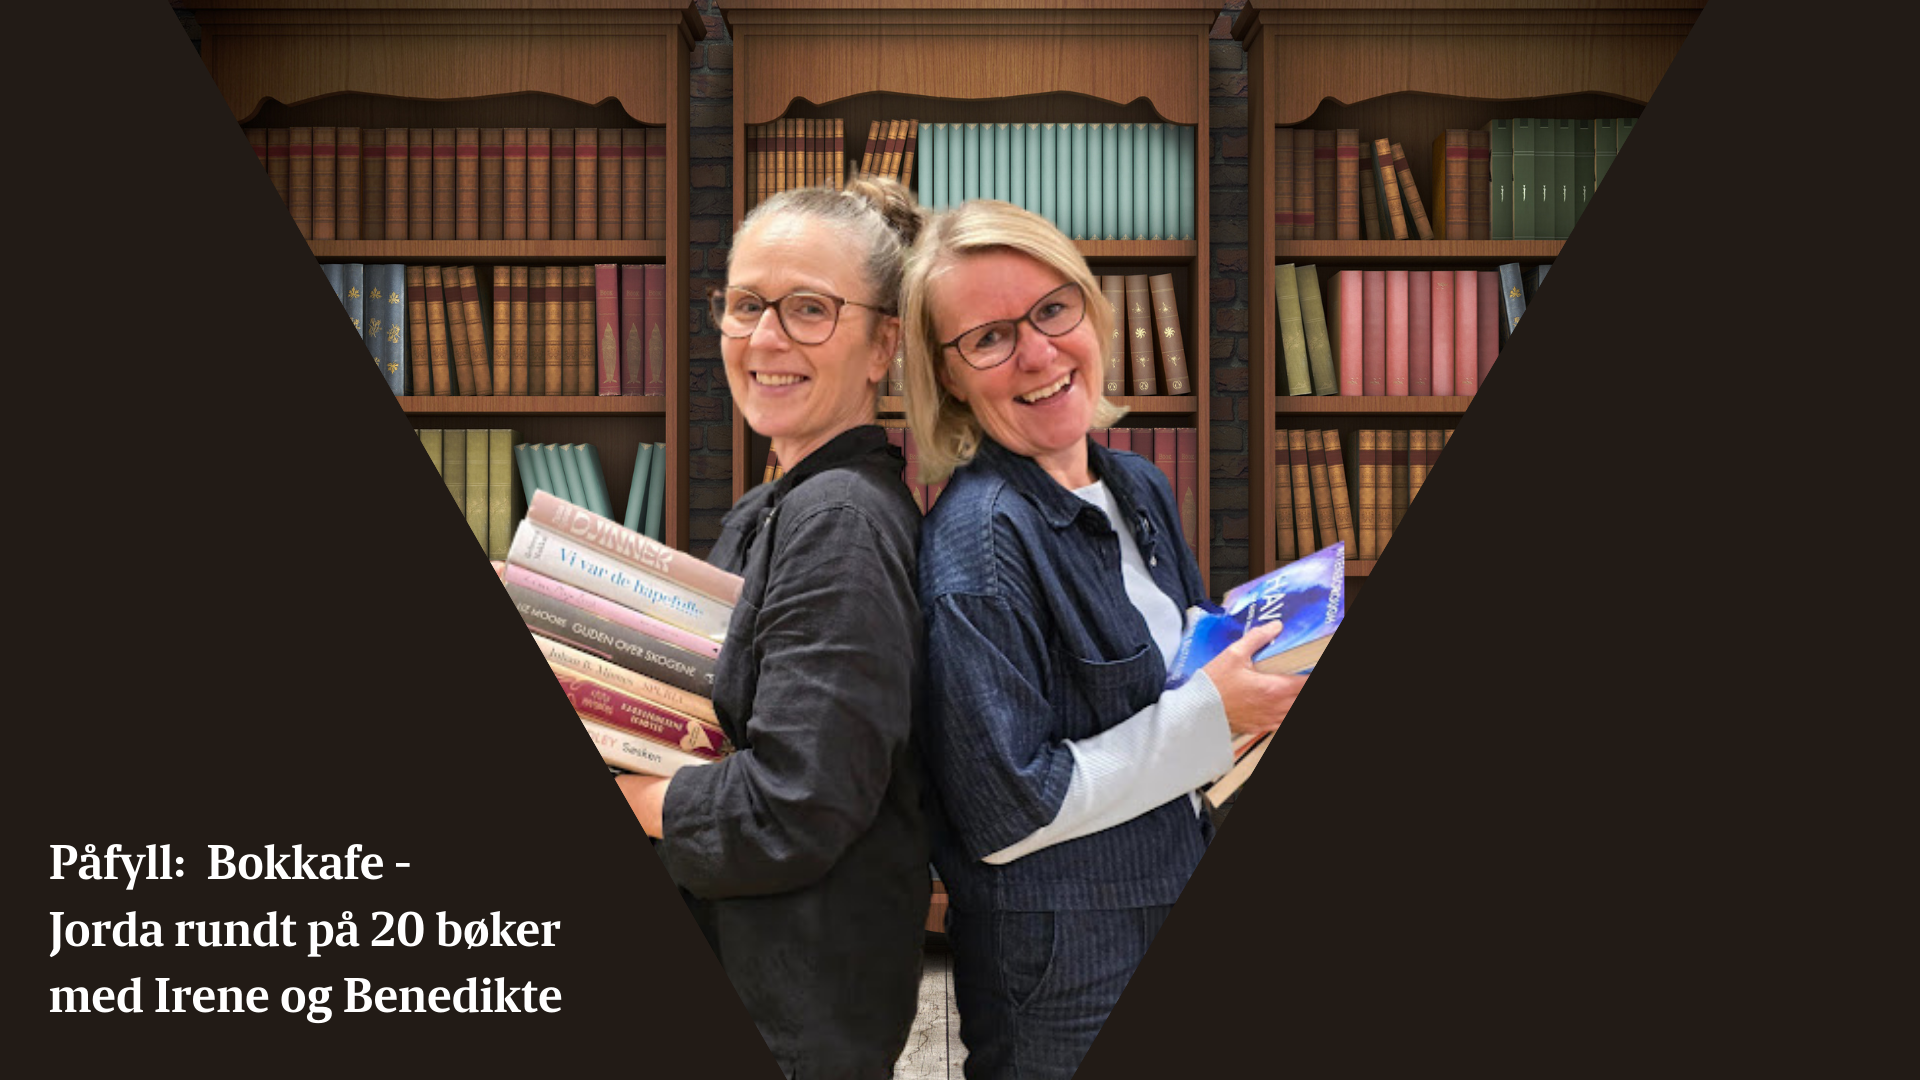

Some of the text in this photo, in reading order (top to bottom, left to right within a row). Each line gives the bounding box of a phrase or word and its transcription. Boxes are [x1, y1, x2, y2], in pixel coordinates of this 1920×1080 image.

[560, 548, 577, 567] Vi
[581, 560, 608, 577] var
[611, 572, 630, 587] de
[570, 511, 674, 573] DJINNER
[531, 609, 567, 628] MOORE
[572, 622, 614, 646] GUDEN
[615, 639, 643, 657] OVER
[645, 650, 696, 677] SKOGENE
